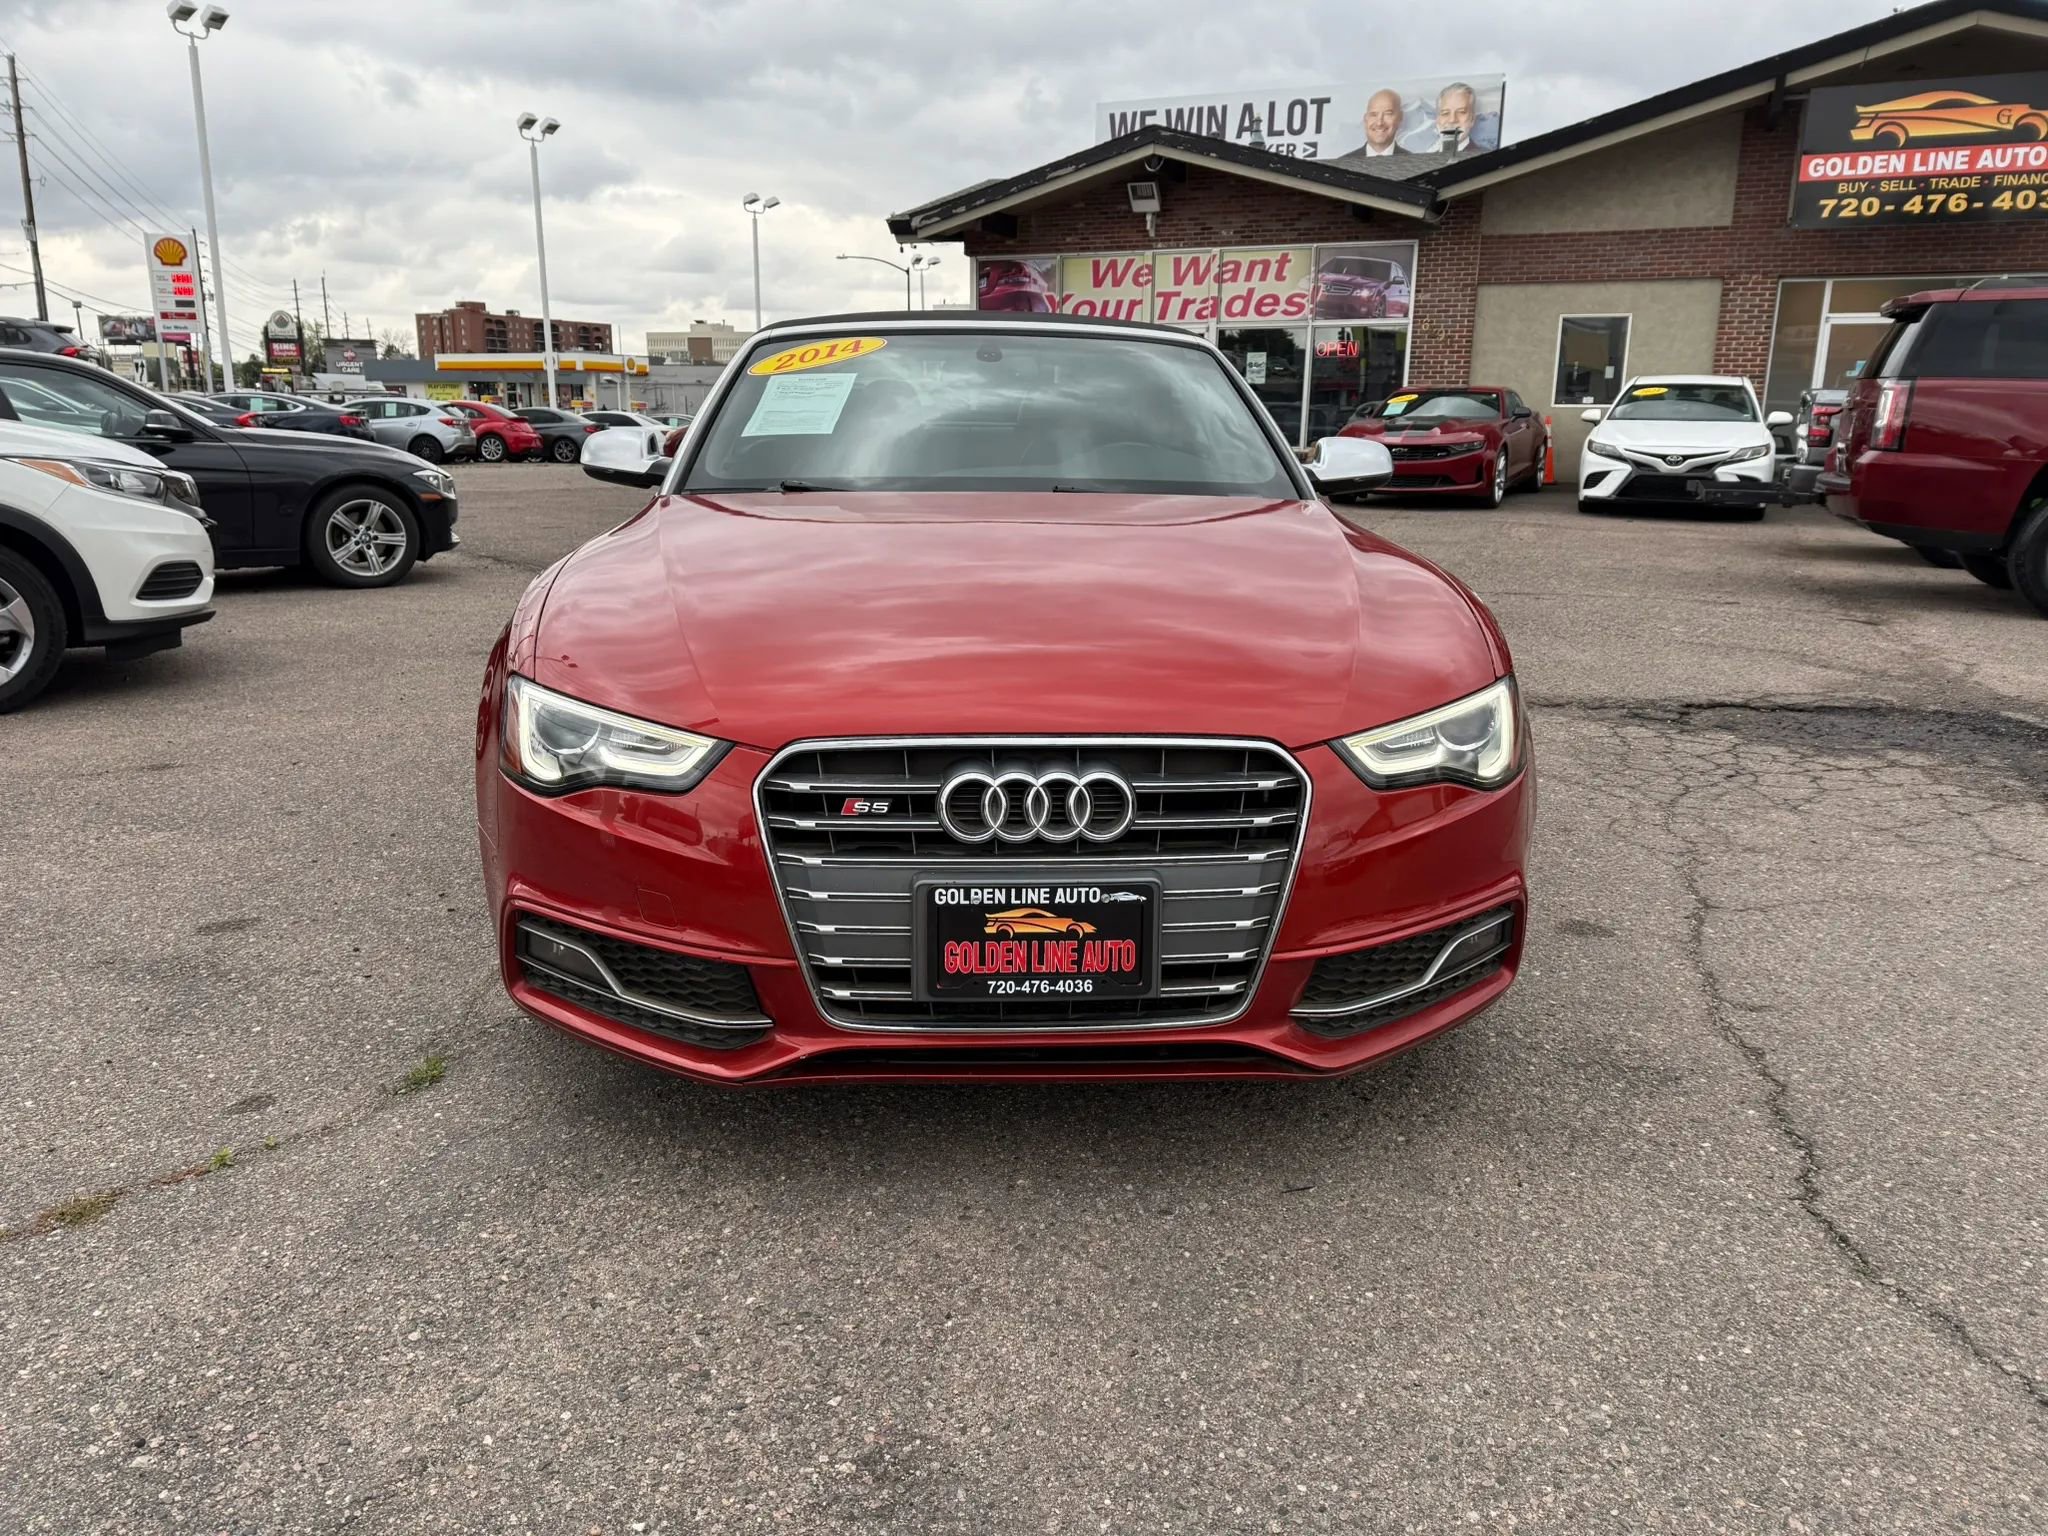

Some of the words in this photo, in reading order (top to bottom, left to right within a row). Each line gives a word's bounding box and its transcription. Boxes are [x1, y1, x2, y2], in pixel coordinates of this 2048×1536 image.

[1165, 104, 1228, 140] WIN
[1235, 102, 1255, 139] A
[1267, 97, 1331, 137] LOT
[1808, 153, 1905, 177] GOLDEN
[1913, 150, 1969, 172] LINE
[1976, 145, 2047, 169] AUTO
[1838, 181, 1868, 194] BUY
[1880, 179, 1917, 192] SELL
[1929, 176, 1981, 189] TRADE
[1091, 257, 1153, 288] We
[1172, 252, 1292, 286] Want
[1044, 293, 1143, 321] Your
[1156, 284, 1322, 320] Trades!
[773, 340, 864, 371] 2014
[1316, 341, 1358, 357] OPEN
[853, 802, 889, 813] S5
[934, 888, 1007, 905] GOLDEN
[1010, 887, 1050, 904] LINE
[1055, 887, 1101, 904] AUTO
[944, 940, 1027, 974] GOLDEN
[1031, 939, 1078, 973] LINE
[1082, 938, 1136, 973] AUTO
[987, 979, 1093, 994] 720-476-4036
